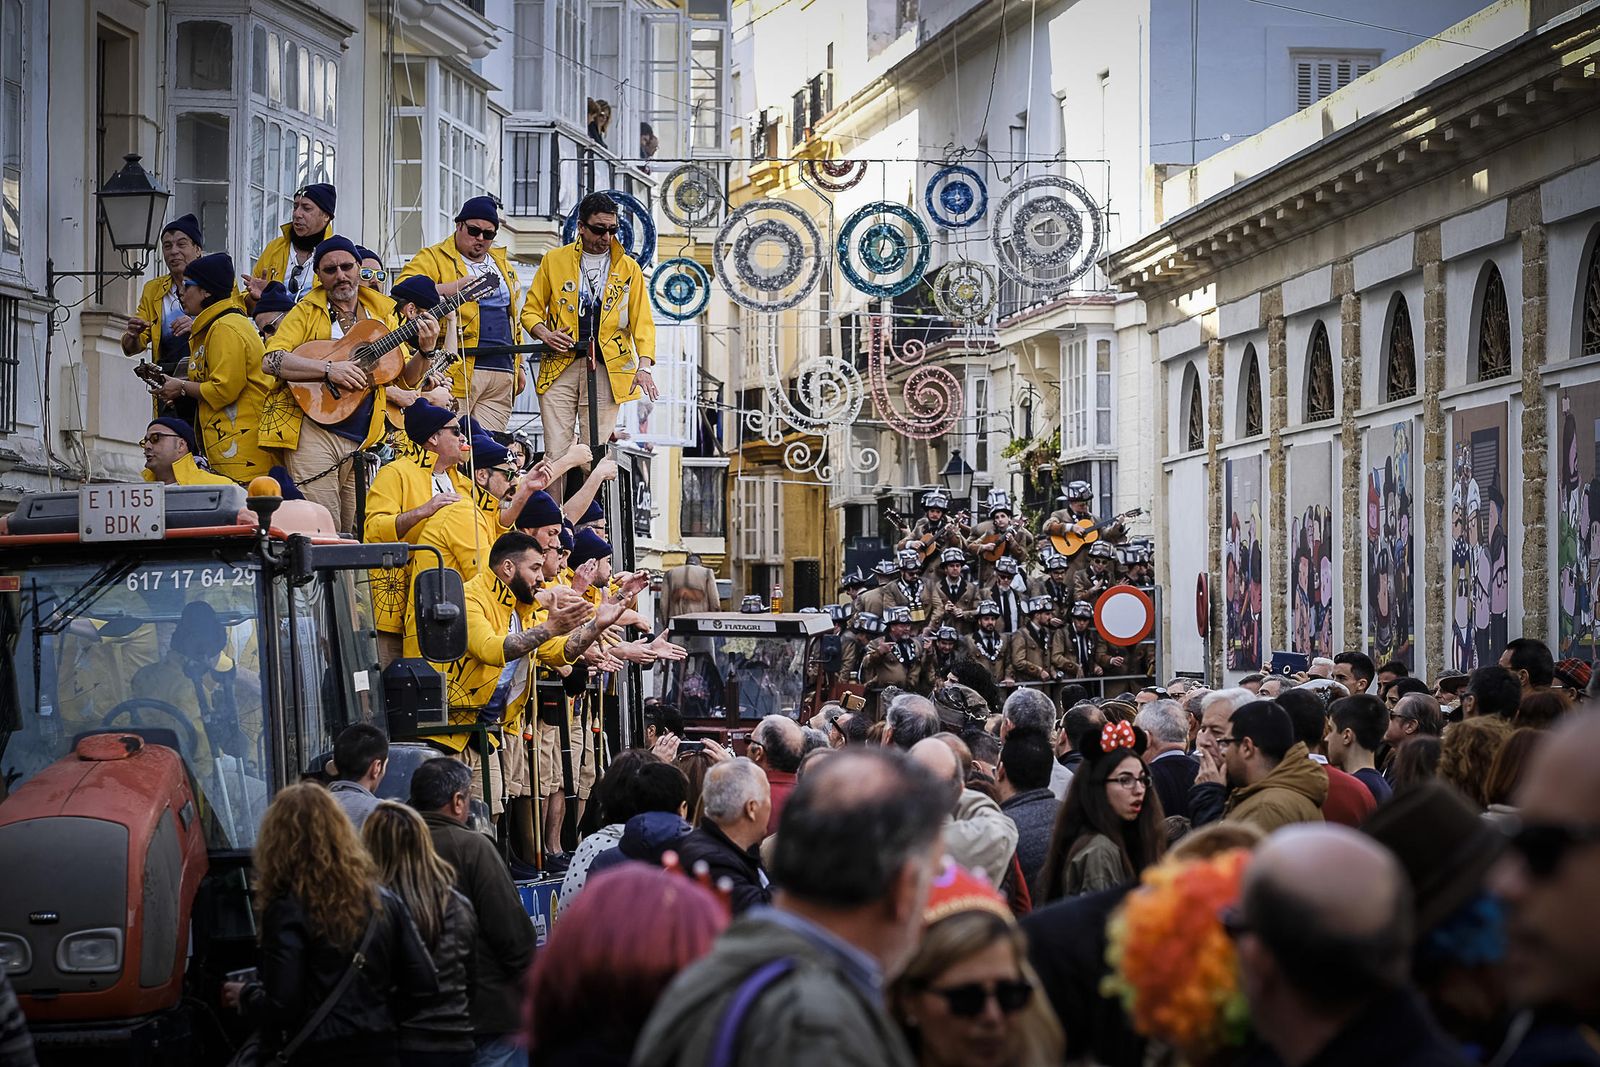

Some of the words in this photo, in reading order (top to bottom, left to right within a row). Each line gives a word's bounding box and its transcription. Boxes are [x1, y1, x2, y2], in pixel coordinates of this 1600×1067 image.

[612, 335, 627, 355] E
[89, 490, 100, 509] E
[107, 488, 154, 509] 1155
[105, 515, 141, 535] BDK
[126, 571, 163, 591] 617
[170, 569, 194, 589] 17
[201, 567, 225, 588] 64
[231, 567, 257, 587] 29
